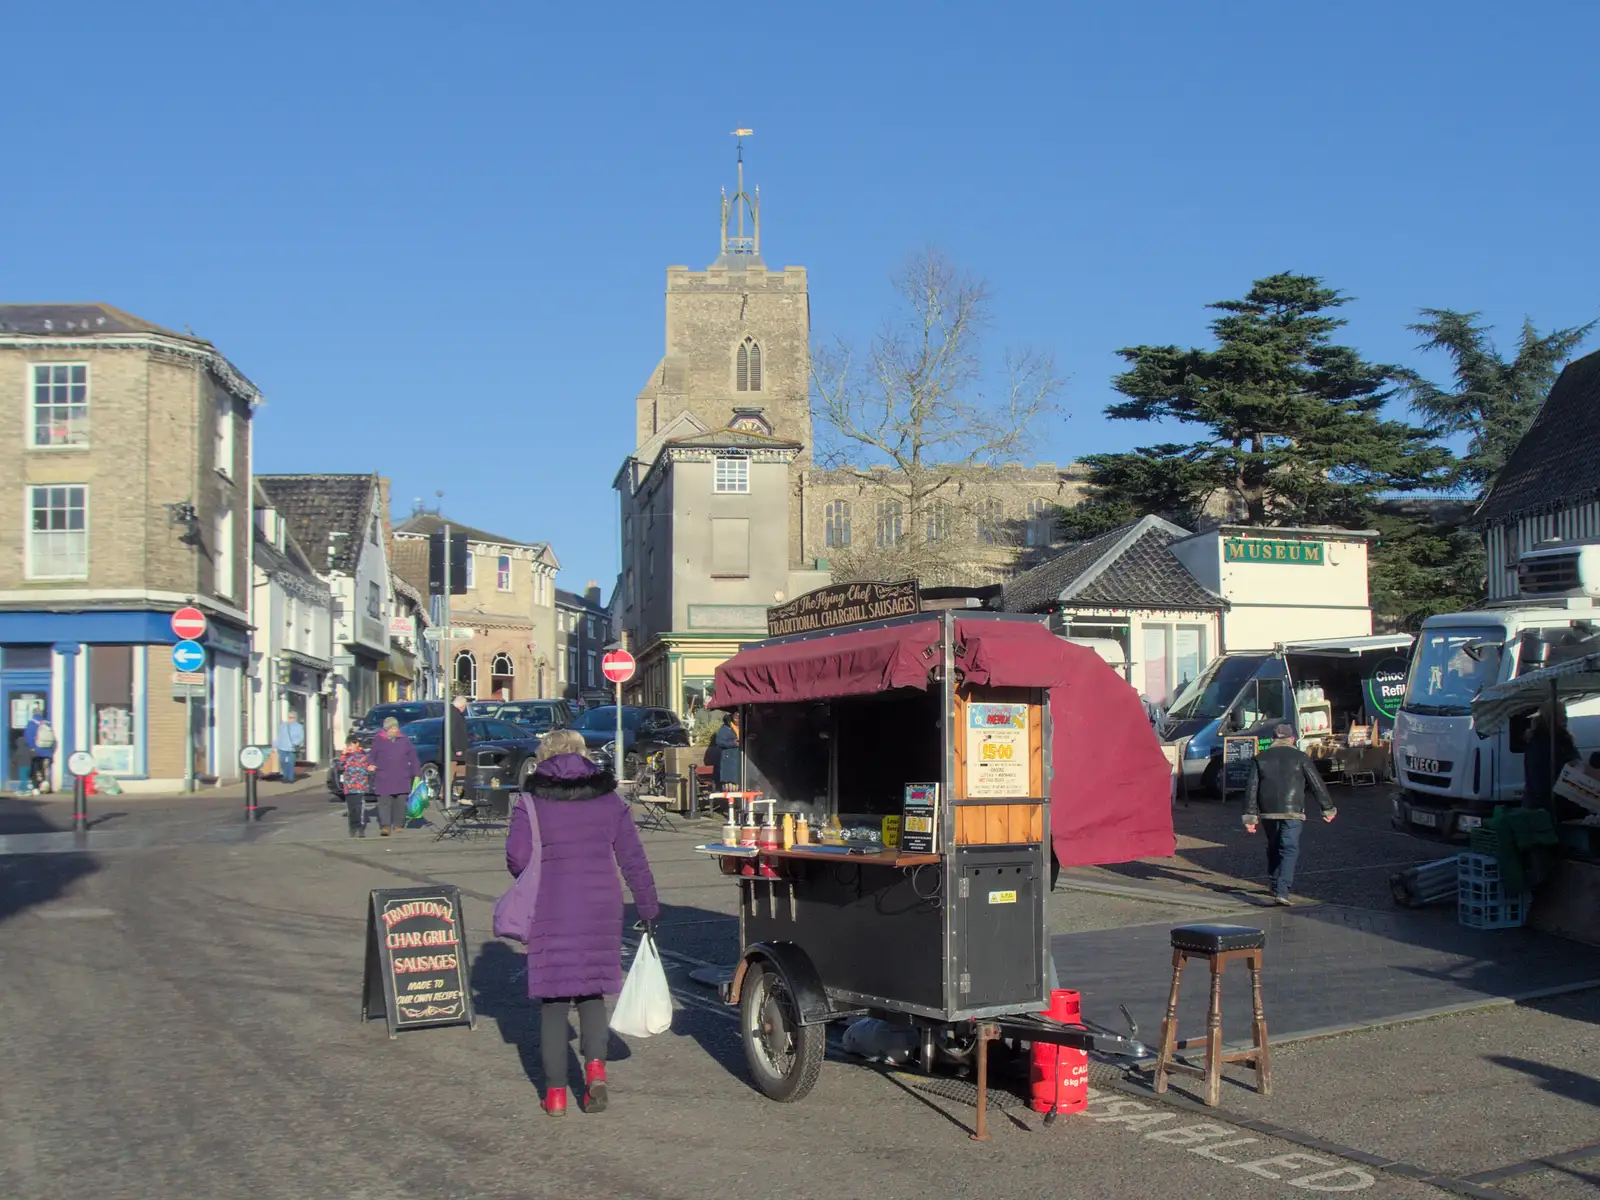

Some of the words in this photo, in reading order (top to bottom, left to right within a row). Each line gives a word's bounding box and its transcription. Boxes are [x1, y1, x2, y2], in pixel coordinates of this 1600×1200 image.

[1229, 543, 1320, 561] MUSEUM
[800, 595, 816, 613] The
[815, 590, 845, 609] Flying
[847, 583, 871, 603] Chef
[768, 612, 821, 636] TRADITIONAL
[821, 604, 868, 627] CHARGRILL
[868, 595, 915, 618] SAUSAGES
[1410, 756, 1440, 773] IVECO
[382, 901, 456, 928] TRADITIONAL
[386, 931, 422, 949] CHAR
[422, 929, 460, 947] GRILL
[394, 954, 457, 974] SAUSAGES
[433, 979, 444, 988] TO
